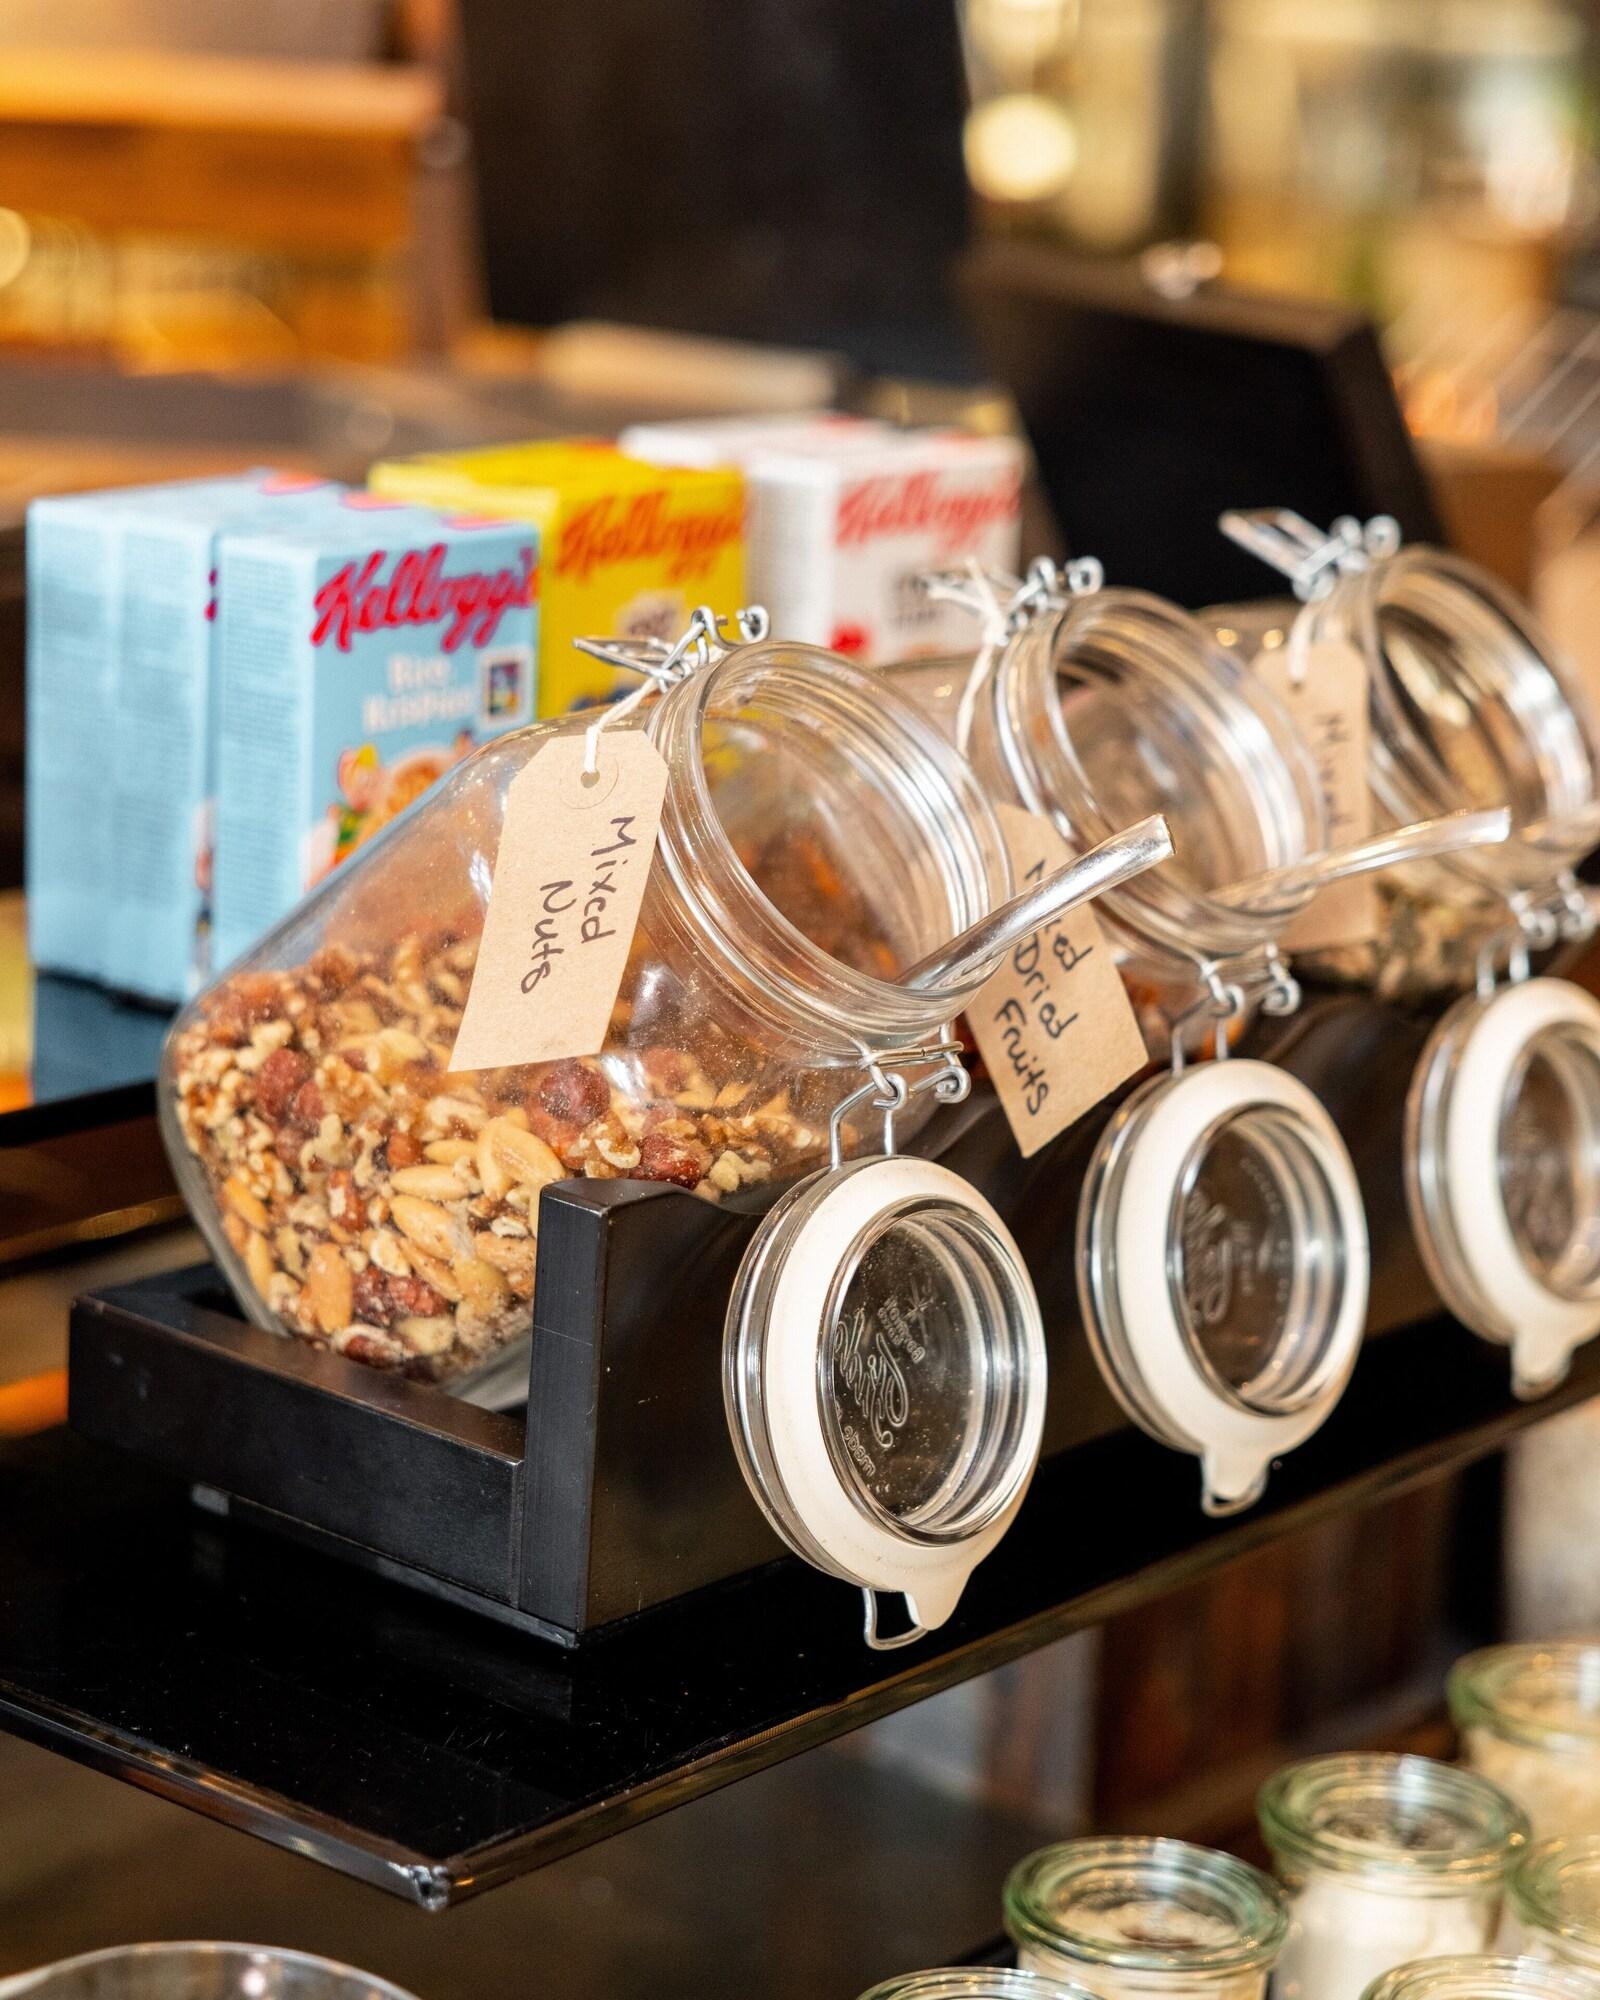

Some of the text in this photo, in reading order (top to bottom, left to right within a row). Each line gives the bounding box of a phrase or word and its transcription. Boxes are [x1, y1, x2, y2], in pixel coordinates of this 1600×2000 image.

[521, 880, 577, 994] Nuts
[581, 815, 637, 944] Mixed
[1013, 932, 1078, 1039] Dried
[994, 997, 1050, 1116] Fruits
